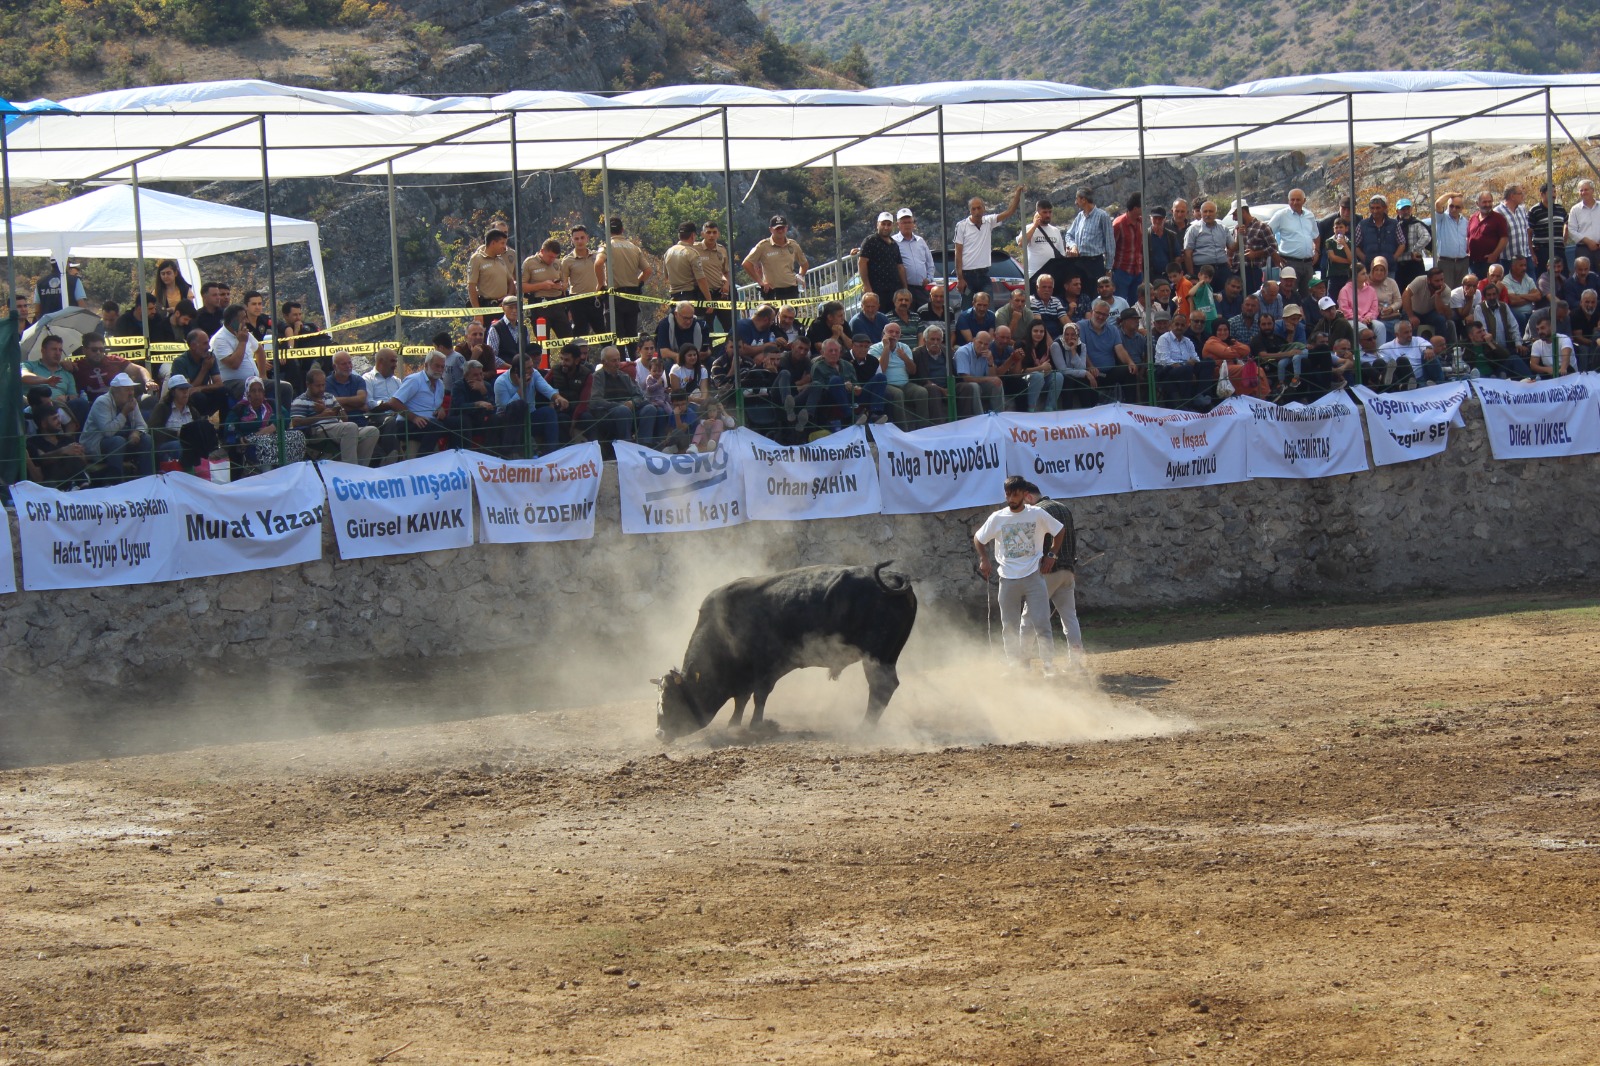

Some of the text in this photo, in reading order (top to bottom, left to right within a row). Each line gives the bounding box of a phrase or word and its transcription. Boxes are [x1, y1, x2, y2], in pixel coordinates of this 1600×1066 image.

[1009, 422, 1121, 448] Koç Teknik Yapı
[1171, 430, 1209, 451] ve İnşaat
[1429, 420, 1450, 442] ŞE
[1509, 419, 1572, 446] Dilek YÜKSEL
[751, 440, 866, 466] İnşaat Mühendisi
[1034, 451, 1105, 474] Ömer KOÇ
[477, 460, 598, 483] Özdemir Ticaret
[888, 451, 921, 483] Tolga
[1165, 454, 1217, 481] Aykut TÜYLÜ
[332, 476, 406, 502] Görkem
[767, 471, 857, 499] Orhan ŞAHİN
[26, 501, 51, 521] CHP
[56, 500, 103, 525] Ardanuç
[126, 498, 168, 522] Başkanı
[186, 504, 324, 542] Murat Yazar
[346, 508, 465, 539] Gürsel KAVAK
[487, 505, 520, 524] Halit
[642, 500, 740, 525] Yusuf kaya
[54, 538, 151, 568] Hafız Eyyüp Uygur
